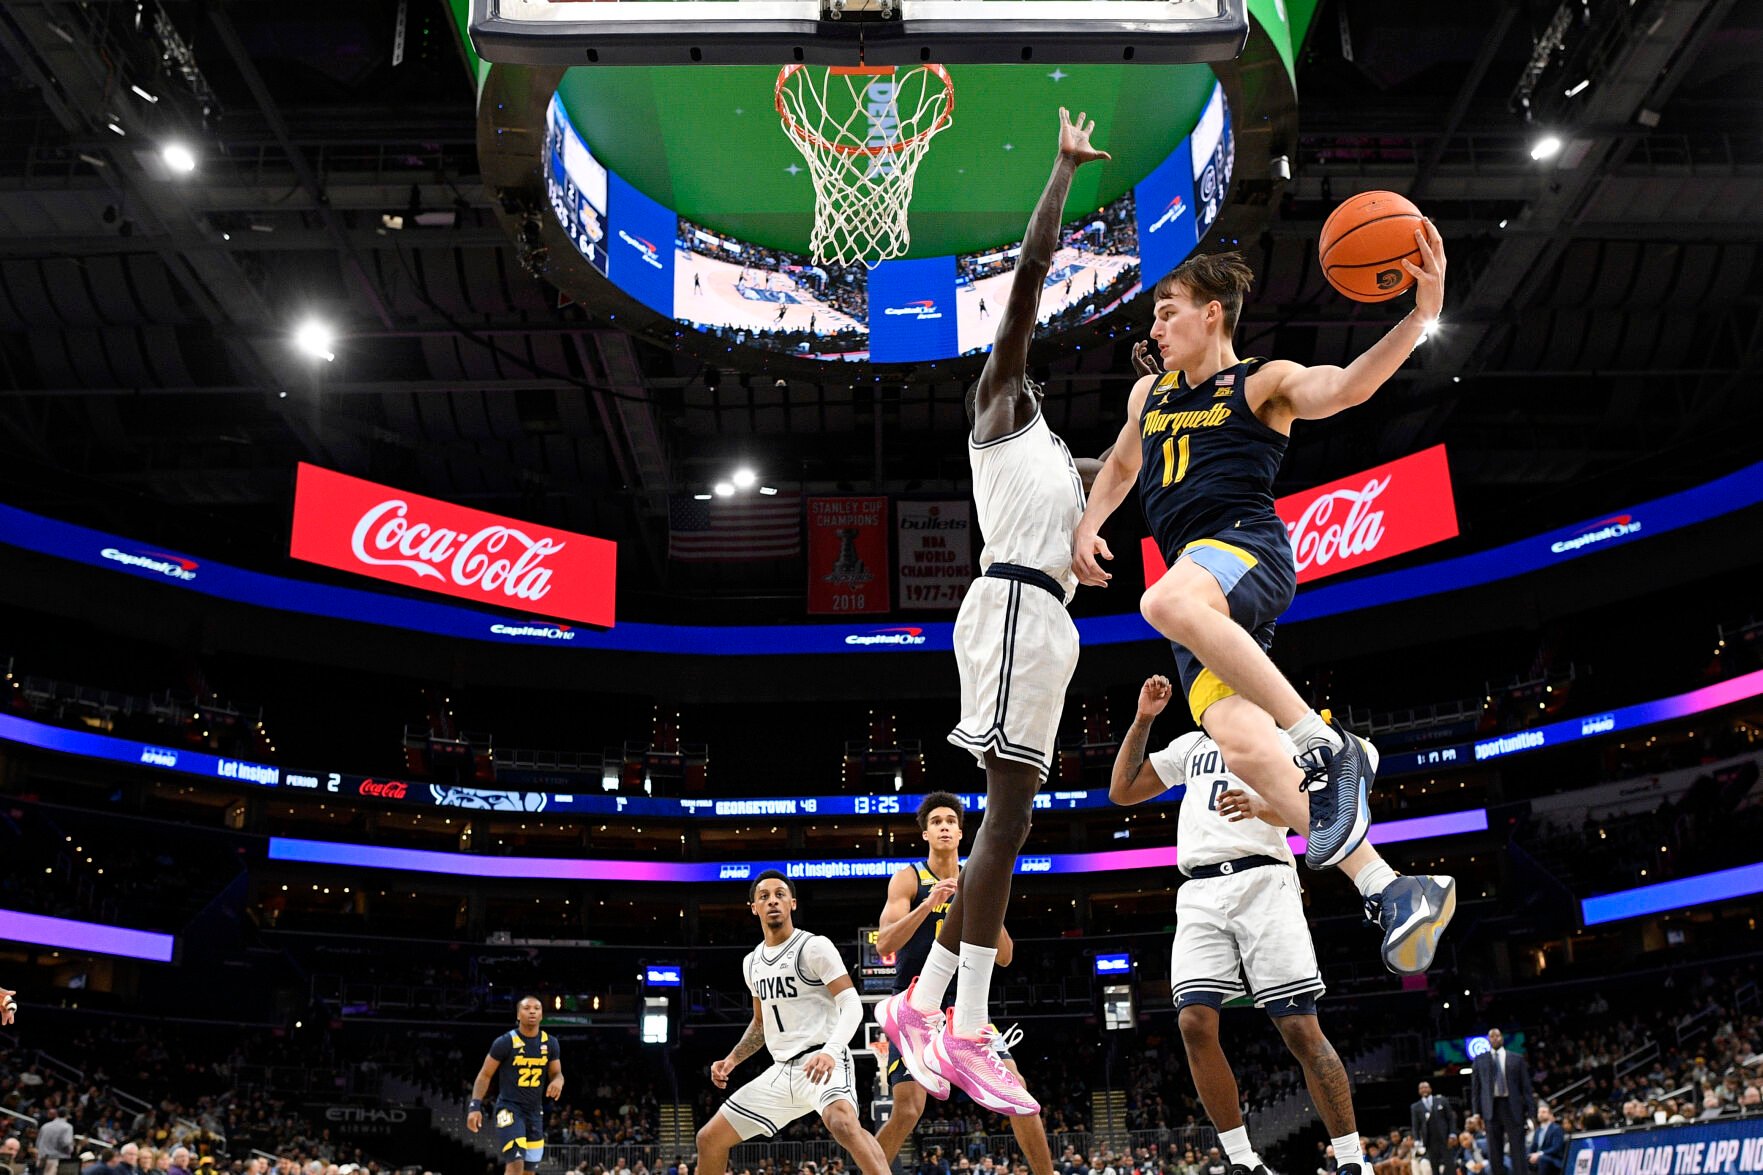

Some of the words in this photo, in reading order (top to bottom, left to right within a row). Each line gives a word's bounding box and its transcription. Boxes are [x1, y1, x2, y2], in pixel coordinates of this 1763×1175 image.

[1142, 402, 1232, 438] Marquette
[1162, 435, 1190, 488] 11
[812, 501, 859, 514] STANLEY
[863, 501, 882, 513] CUP
[816, 514, 880, 527] CHAMPIONS
[901, 516, 967, 530] bullets
[922, 536, 946, 548] NBA
[914, 551, 956, 563] WORLD
[901, 565, 969, 578] CHAMPIONS
[832, 595, 866, 611] 2018
[218, 759, 238, 778] Let
[327, 773, 341, 792] 2
[716, 800, 796, 815] GEORGETOWN
[854, 796, 900, 814] 13:25
[786, 862, 804, 877] Let
[850, 861, 886, 876] reveal
[772, 1005, 785, 1033] 1
[518, 1068, 543, 1088] 22
[324, 1108, 408, 1124] ETIHAD
[1597, 1145, 1673, 1175] DOWNLOAD
[1674, 1142, 1706, 1175] THE
[1702, 1139, 1740, 1173] APP
